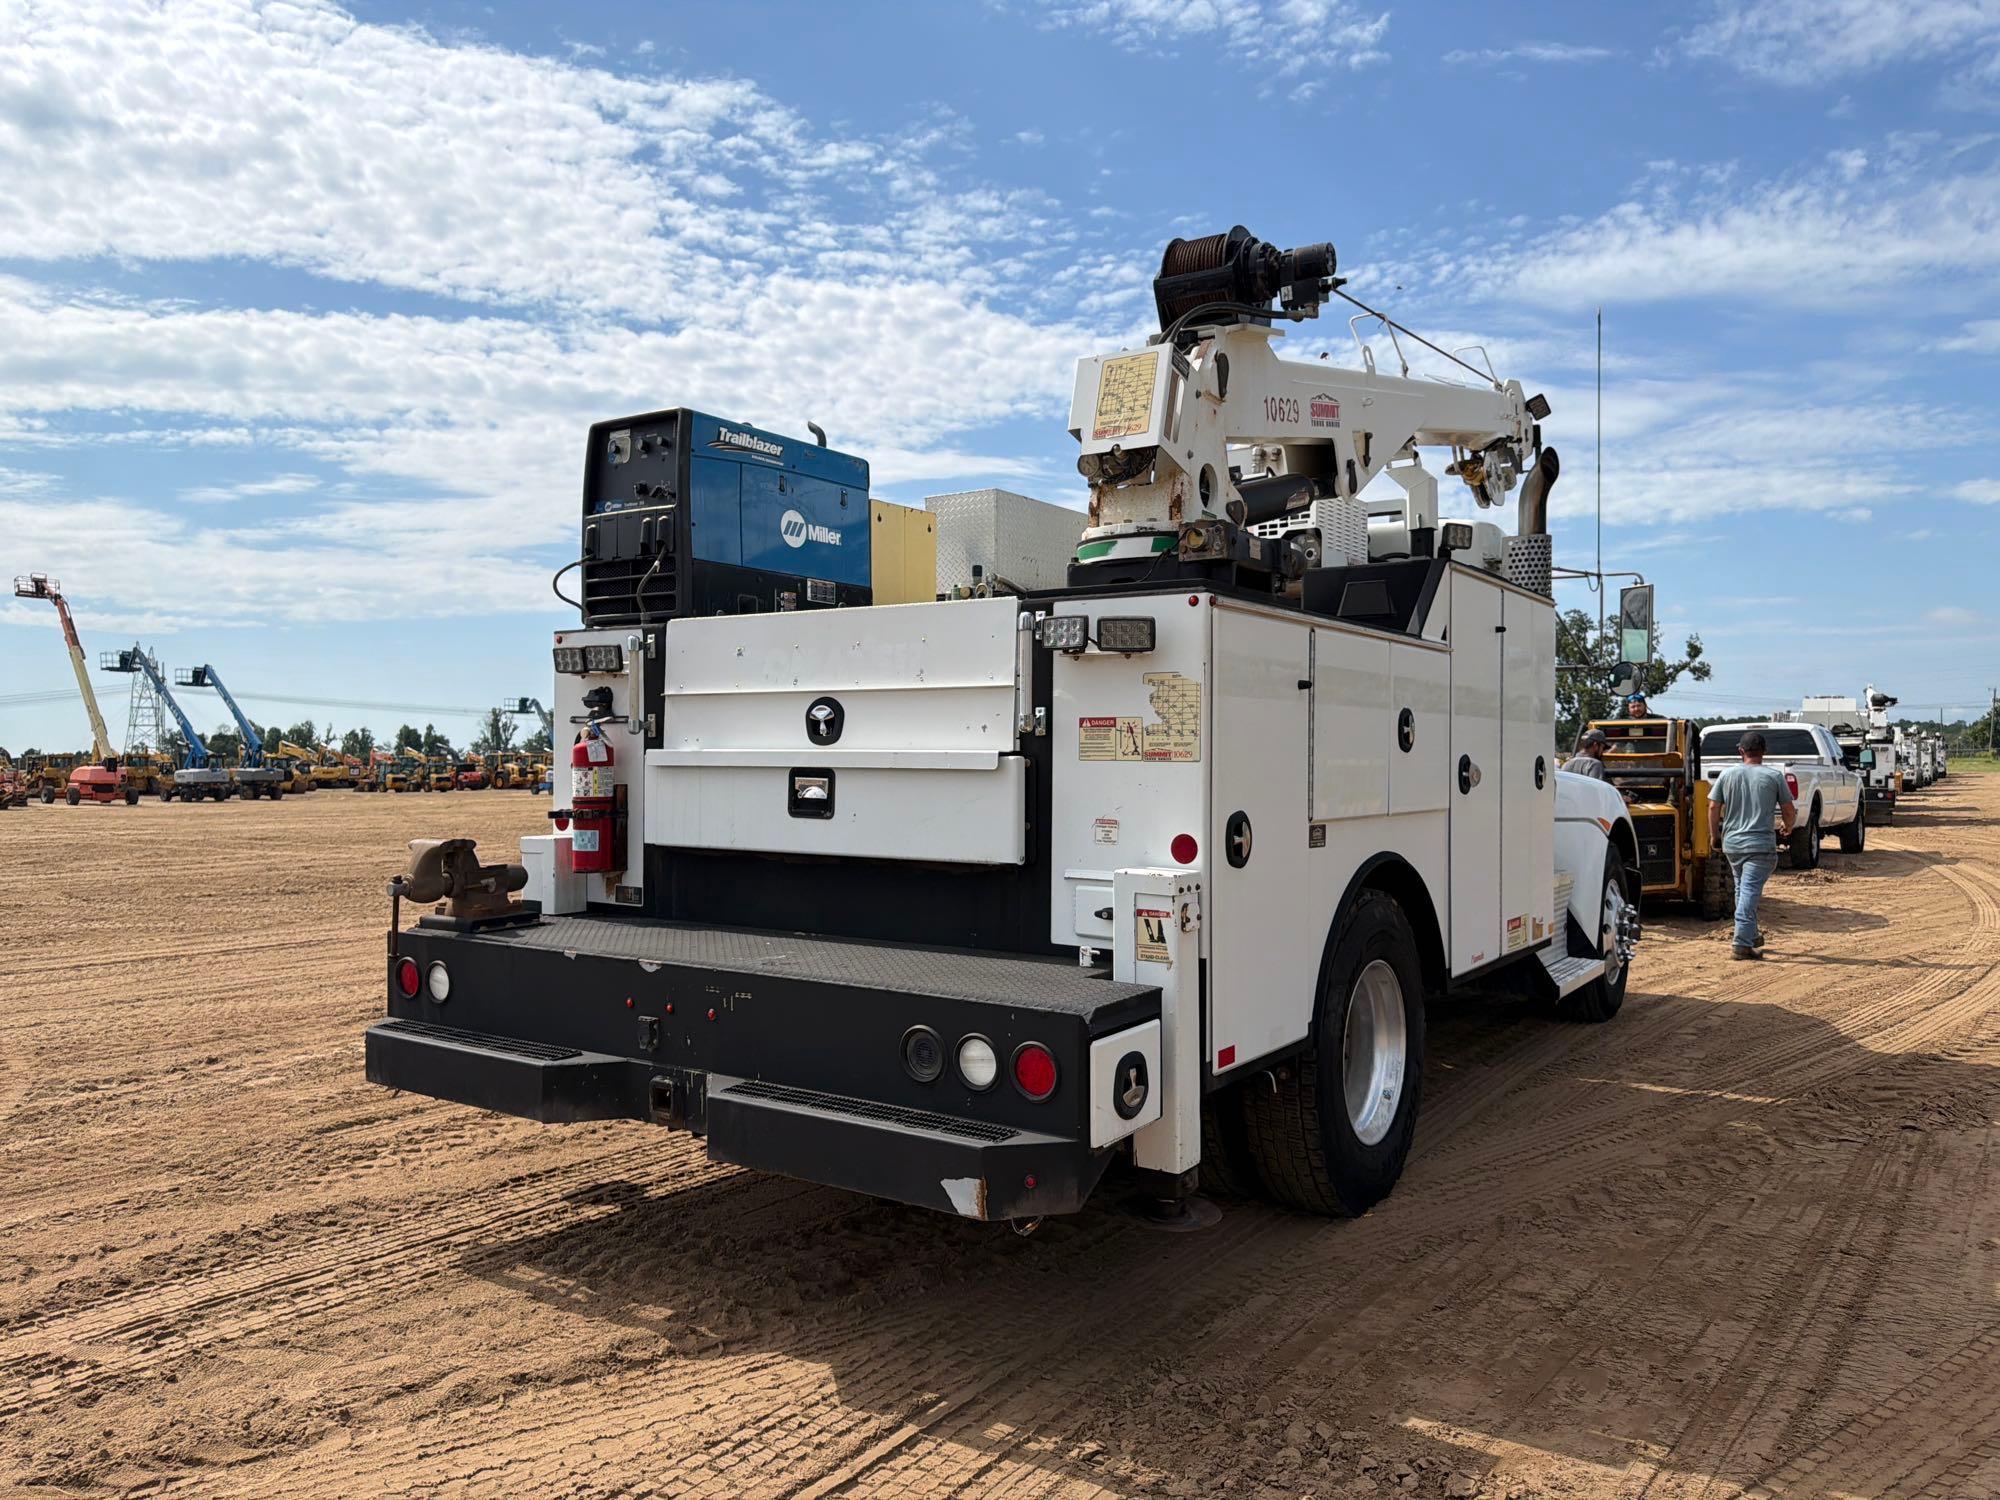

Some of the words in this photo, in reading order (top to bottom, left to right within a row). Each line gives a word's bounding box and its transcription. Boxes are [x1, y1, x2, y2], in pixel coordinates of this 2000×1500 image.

[1263, 396, 1300, 424] 10629
[1310, 403, 1341, 419] SUMMIT
[719, 427, 783, 456] Trailblazer
[808, 524, 841, 546] Miller
